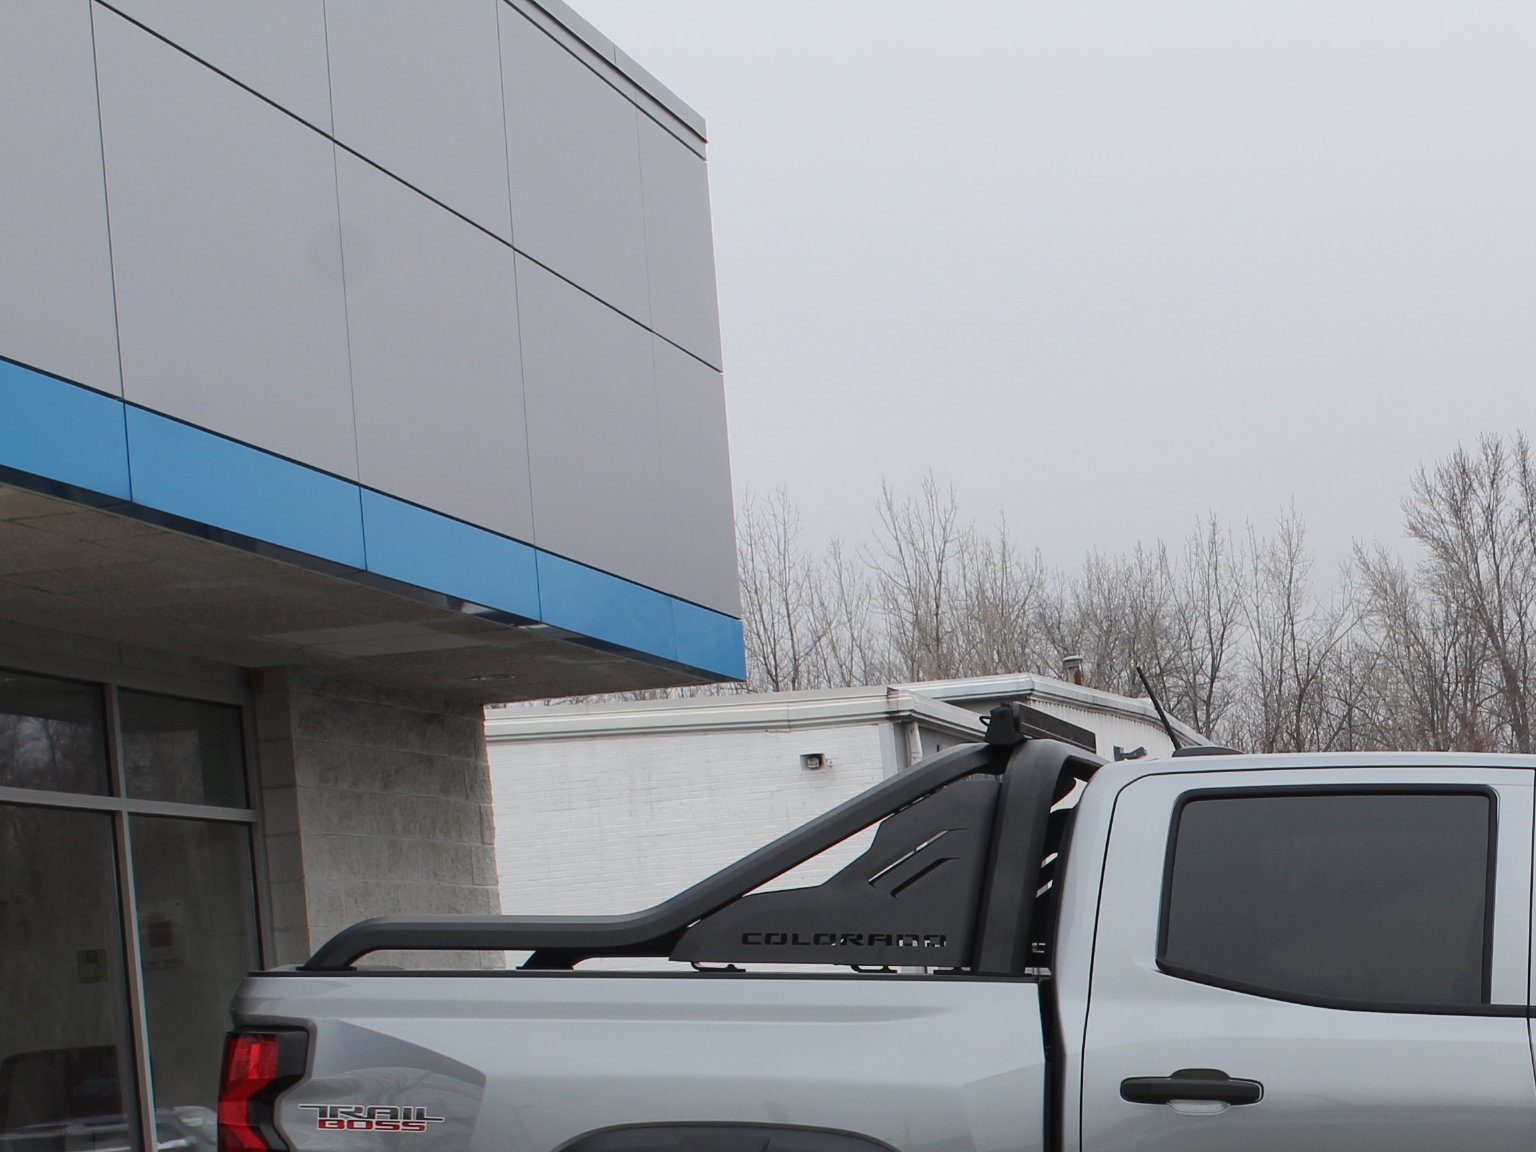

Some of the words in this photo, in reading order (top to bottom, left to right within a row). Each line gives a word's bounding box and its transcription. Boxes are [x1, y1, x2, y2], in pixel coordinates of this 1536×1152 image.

[741, 933, 947, 948] COLORADO
[298, 1103, 445, 1123] TRAIL
[316, 1118, 428, 1133] BOSS
